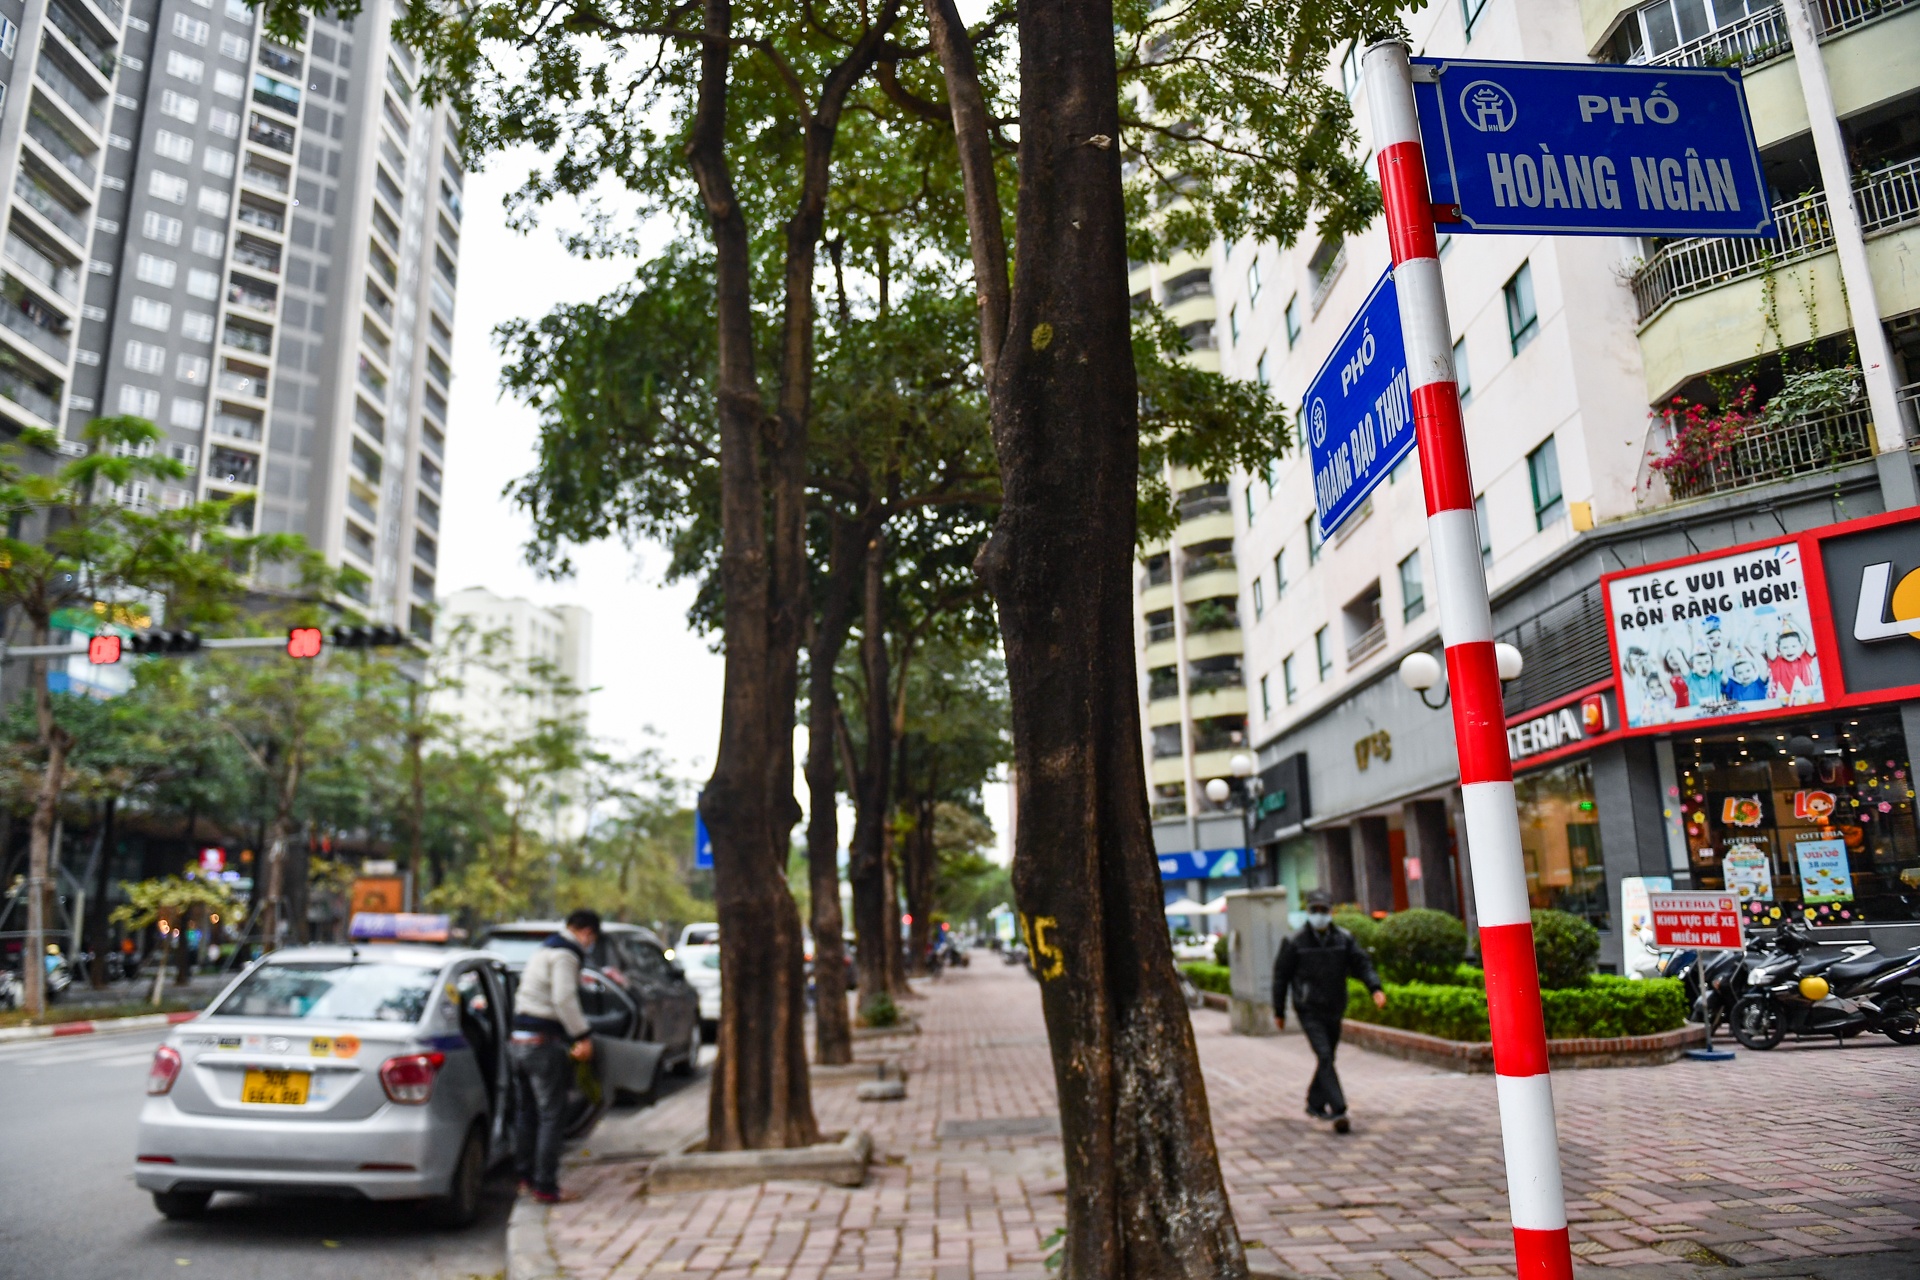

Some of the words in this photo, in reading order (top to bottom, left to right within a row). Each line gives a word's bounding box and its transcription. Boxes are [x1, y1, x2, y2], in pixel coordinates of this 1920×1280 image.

[1578, 82, 1679, 124] PHỐ
[1487, 143, 1622, 209] HOÀNG
[1631, 148, 1741, 211] NGÂN
[1341, 316, 1376, 397] PHỐ
[1317, 442, 1352, 519] HOÀNG
[1350, 412, 1377, 478] ĐẠO
[1375, 366, 1410, 449] THÚY
[1628, 578, 1678, 604] TIỆC
[1686, 570, 1724, 593] VUI
[1733, 559, 1781, 583] HƠN
[1620, 605, 1664, 631] RỘN
[1672, 595, 1733, 621] RÀNG
[1742, 581, 1799, 608] HƠN!
[1796, 831, 1844, 840] LOTTERIA
[1654, 900, 1715, 908] LOTTERIA
[1656, 914, 1678, 926] KHU
[1721, 915, 1736, 927] XE
[1702, 931, 1721, 944] PHÍ
